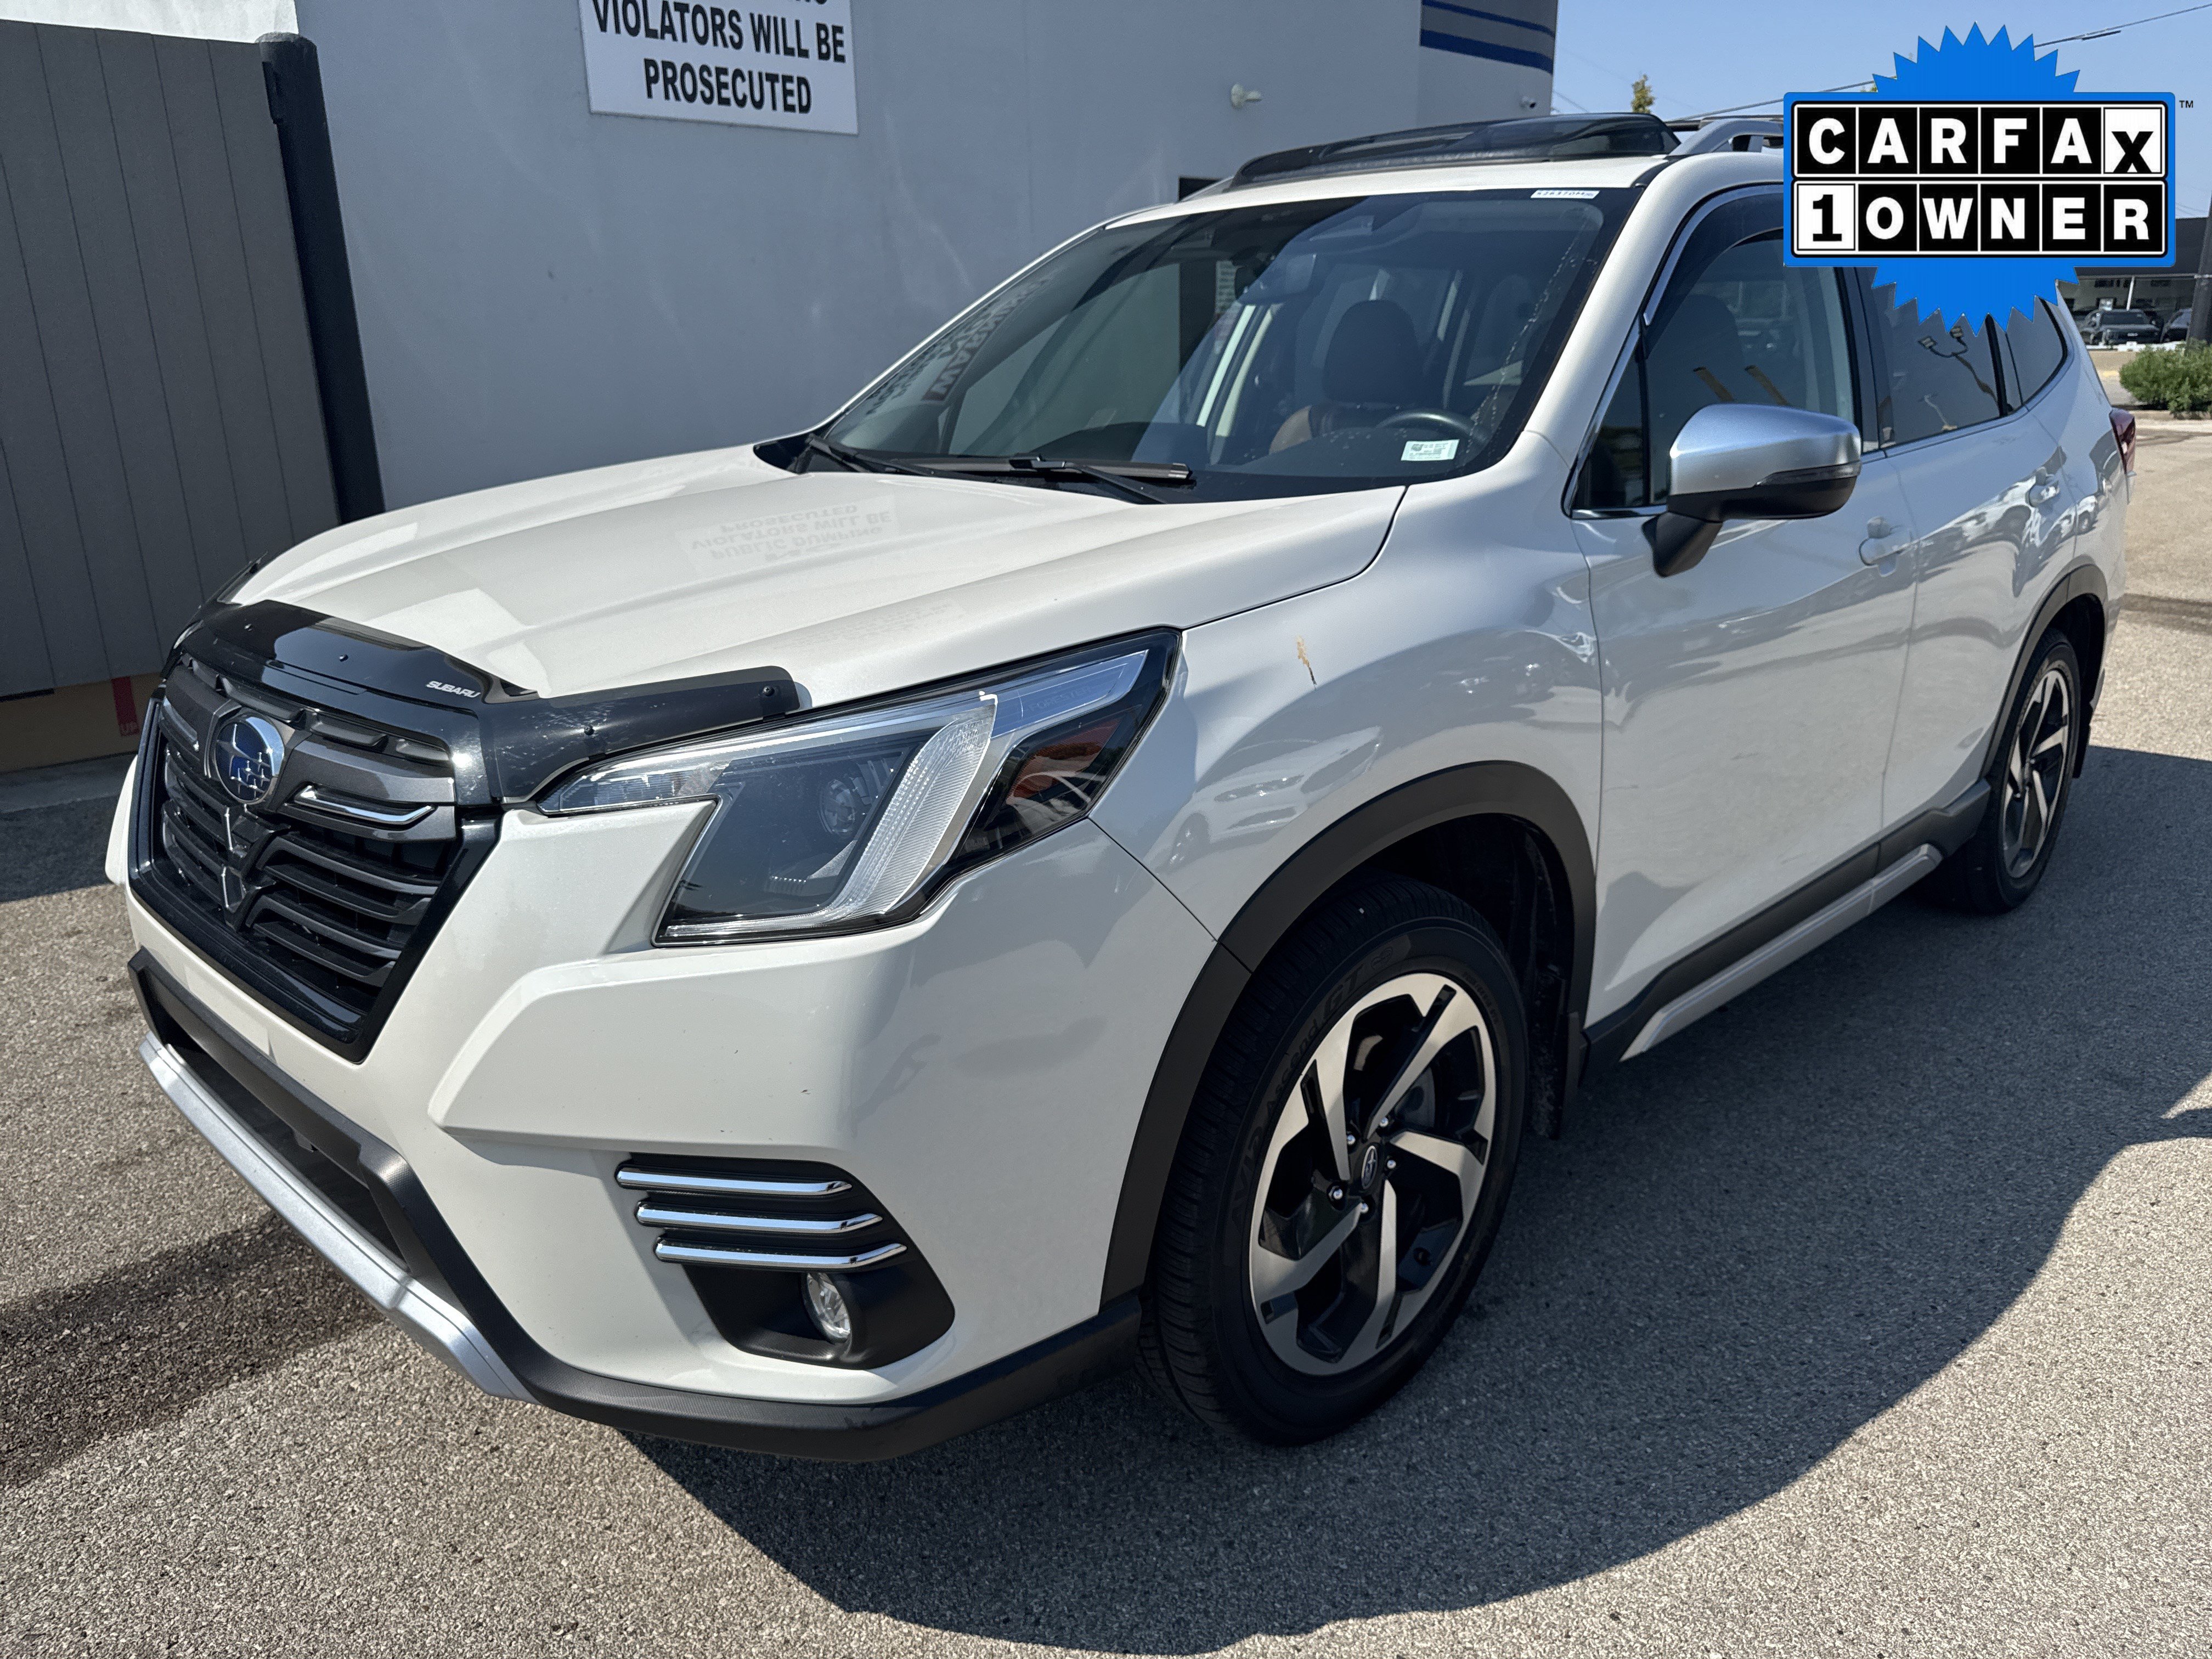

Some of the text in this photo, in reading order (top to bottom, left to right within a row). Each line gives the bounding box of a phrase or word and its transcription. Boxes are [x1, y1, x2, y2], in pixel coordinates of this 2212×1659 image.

[592, 0, 847, 63] VIOLATORS WILL BE
[644, 58, 812, 114] PROSECUTED
[426, 680, 481, 698] SUBARU
[1029, 686, 1092, 712] FORESTER
[1265, 1019, 1320, 1116] Ascend
[1325, 967, 1363, 1018] GT
